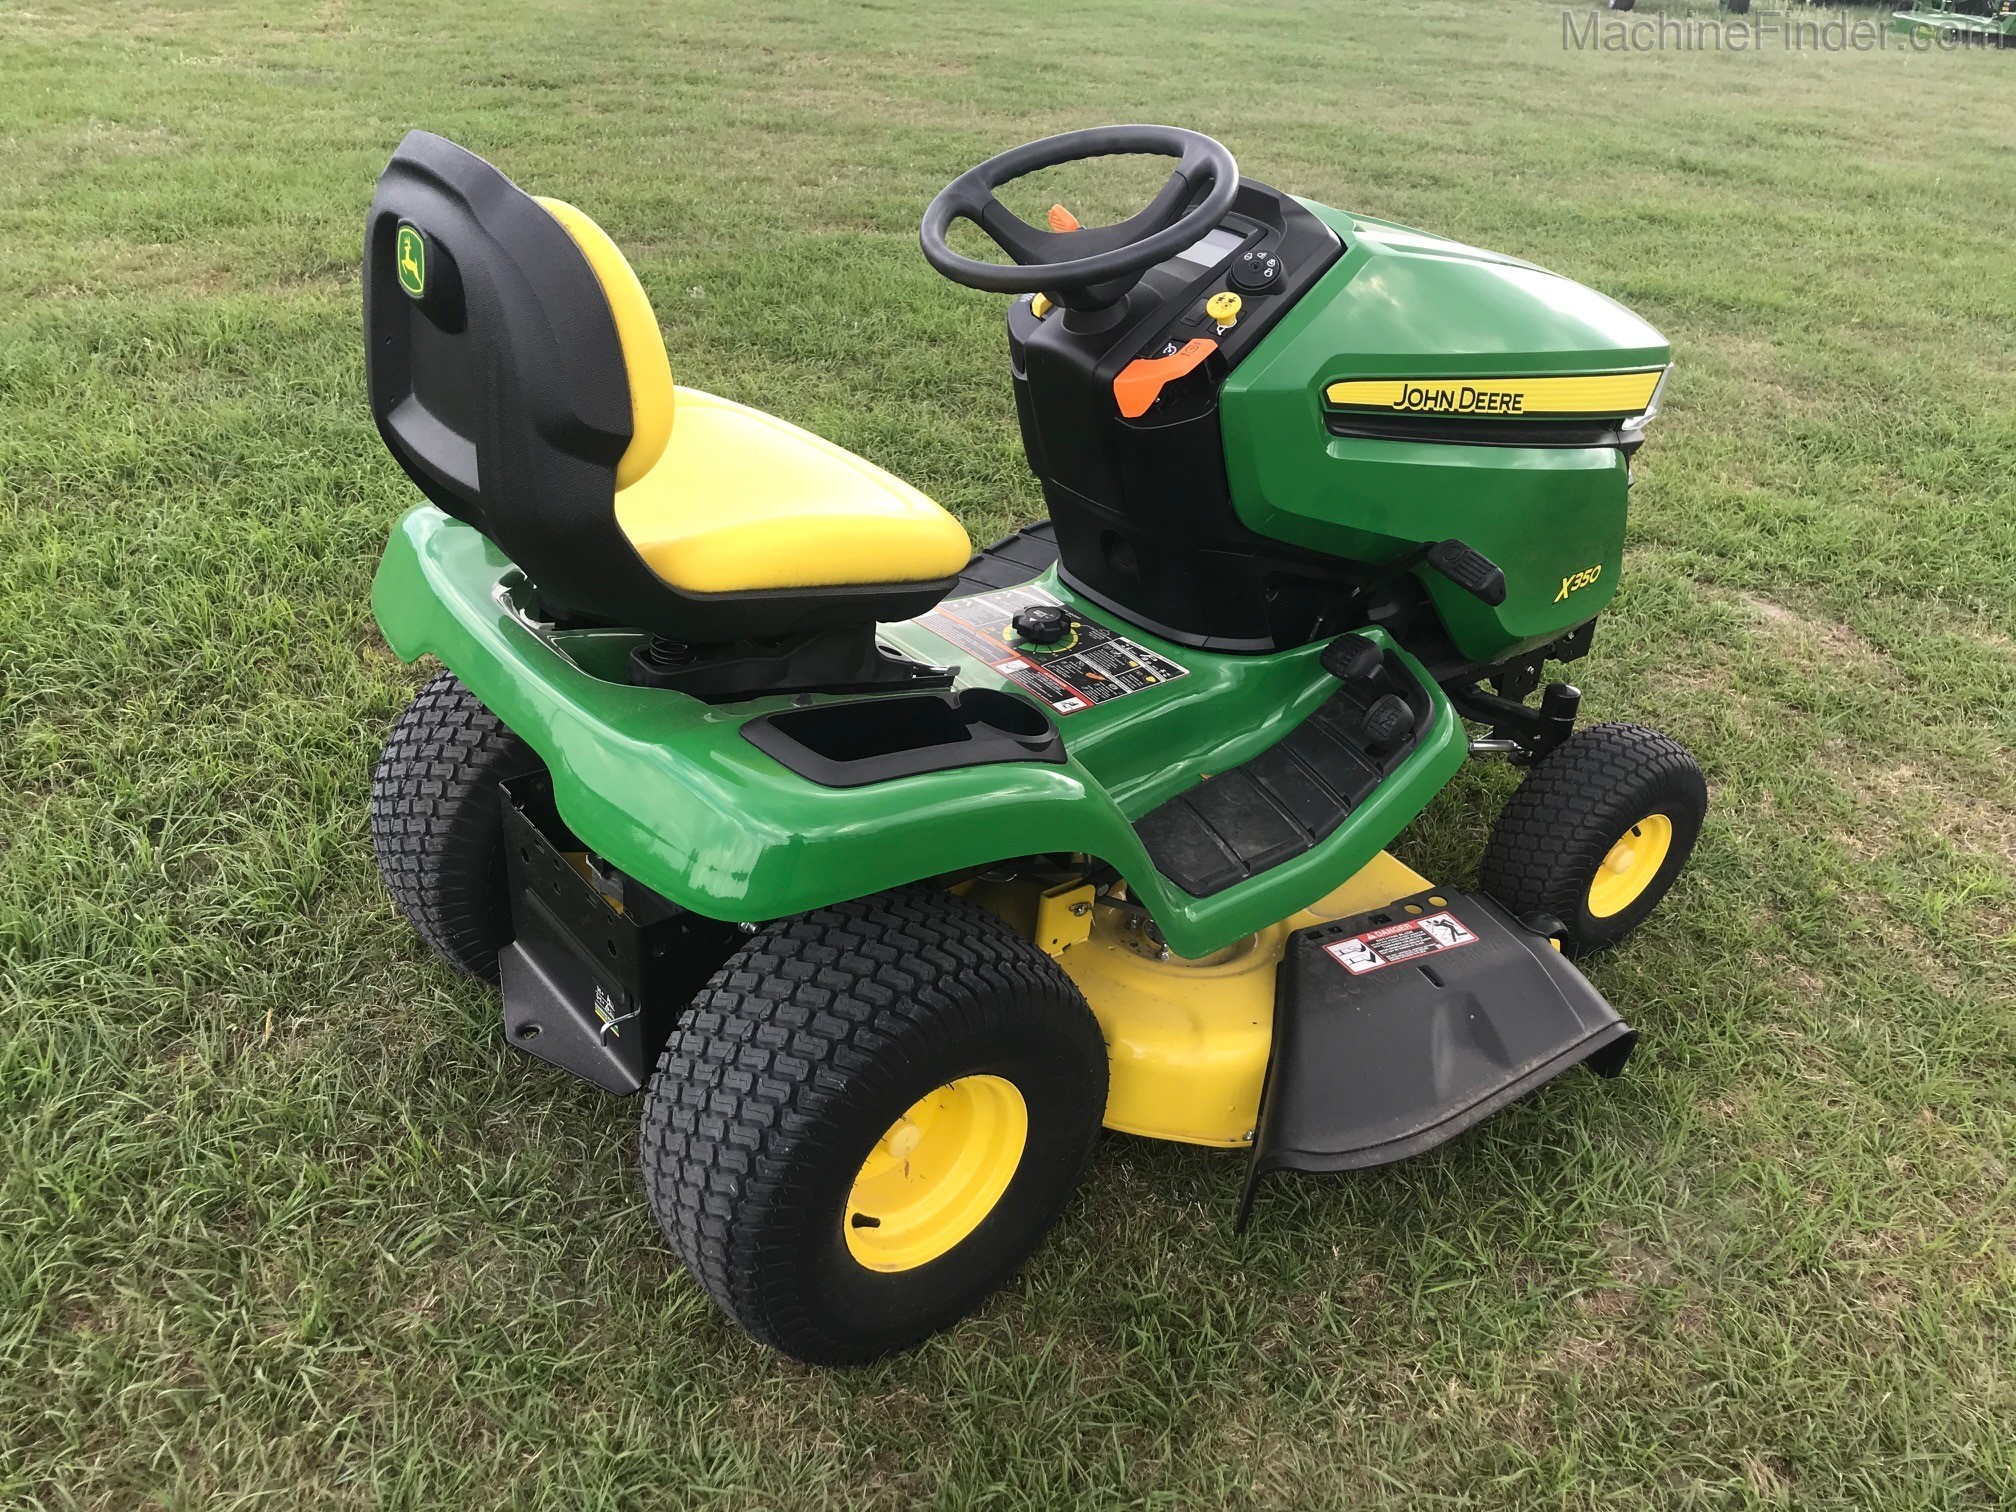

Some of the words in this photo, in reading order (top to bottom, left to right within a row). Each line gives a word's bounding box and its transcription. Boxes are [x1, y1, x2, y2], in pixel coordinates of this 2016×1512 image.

[1393, 383, 1455, 410] JOHN
[1458, 386, 1524, 411] DEERE
[1553, 564, 1602, 603] X350
[1374, 922, 1413, 938] DANGER
